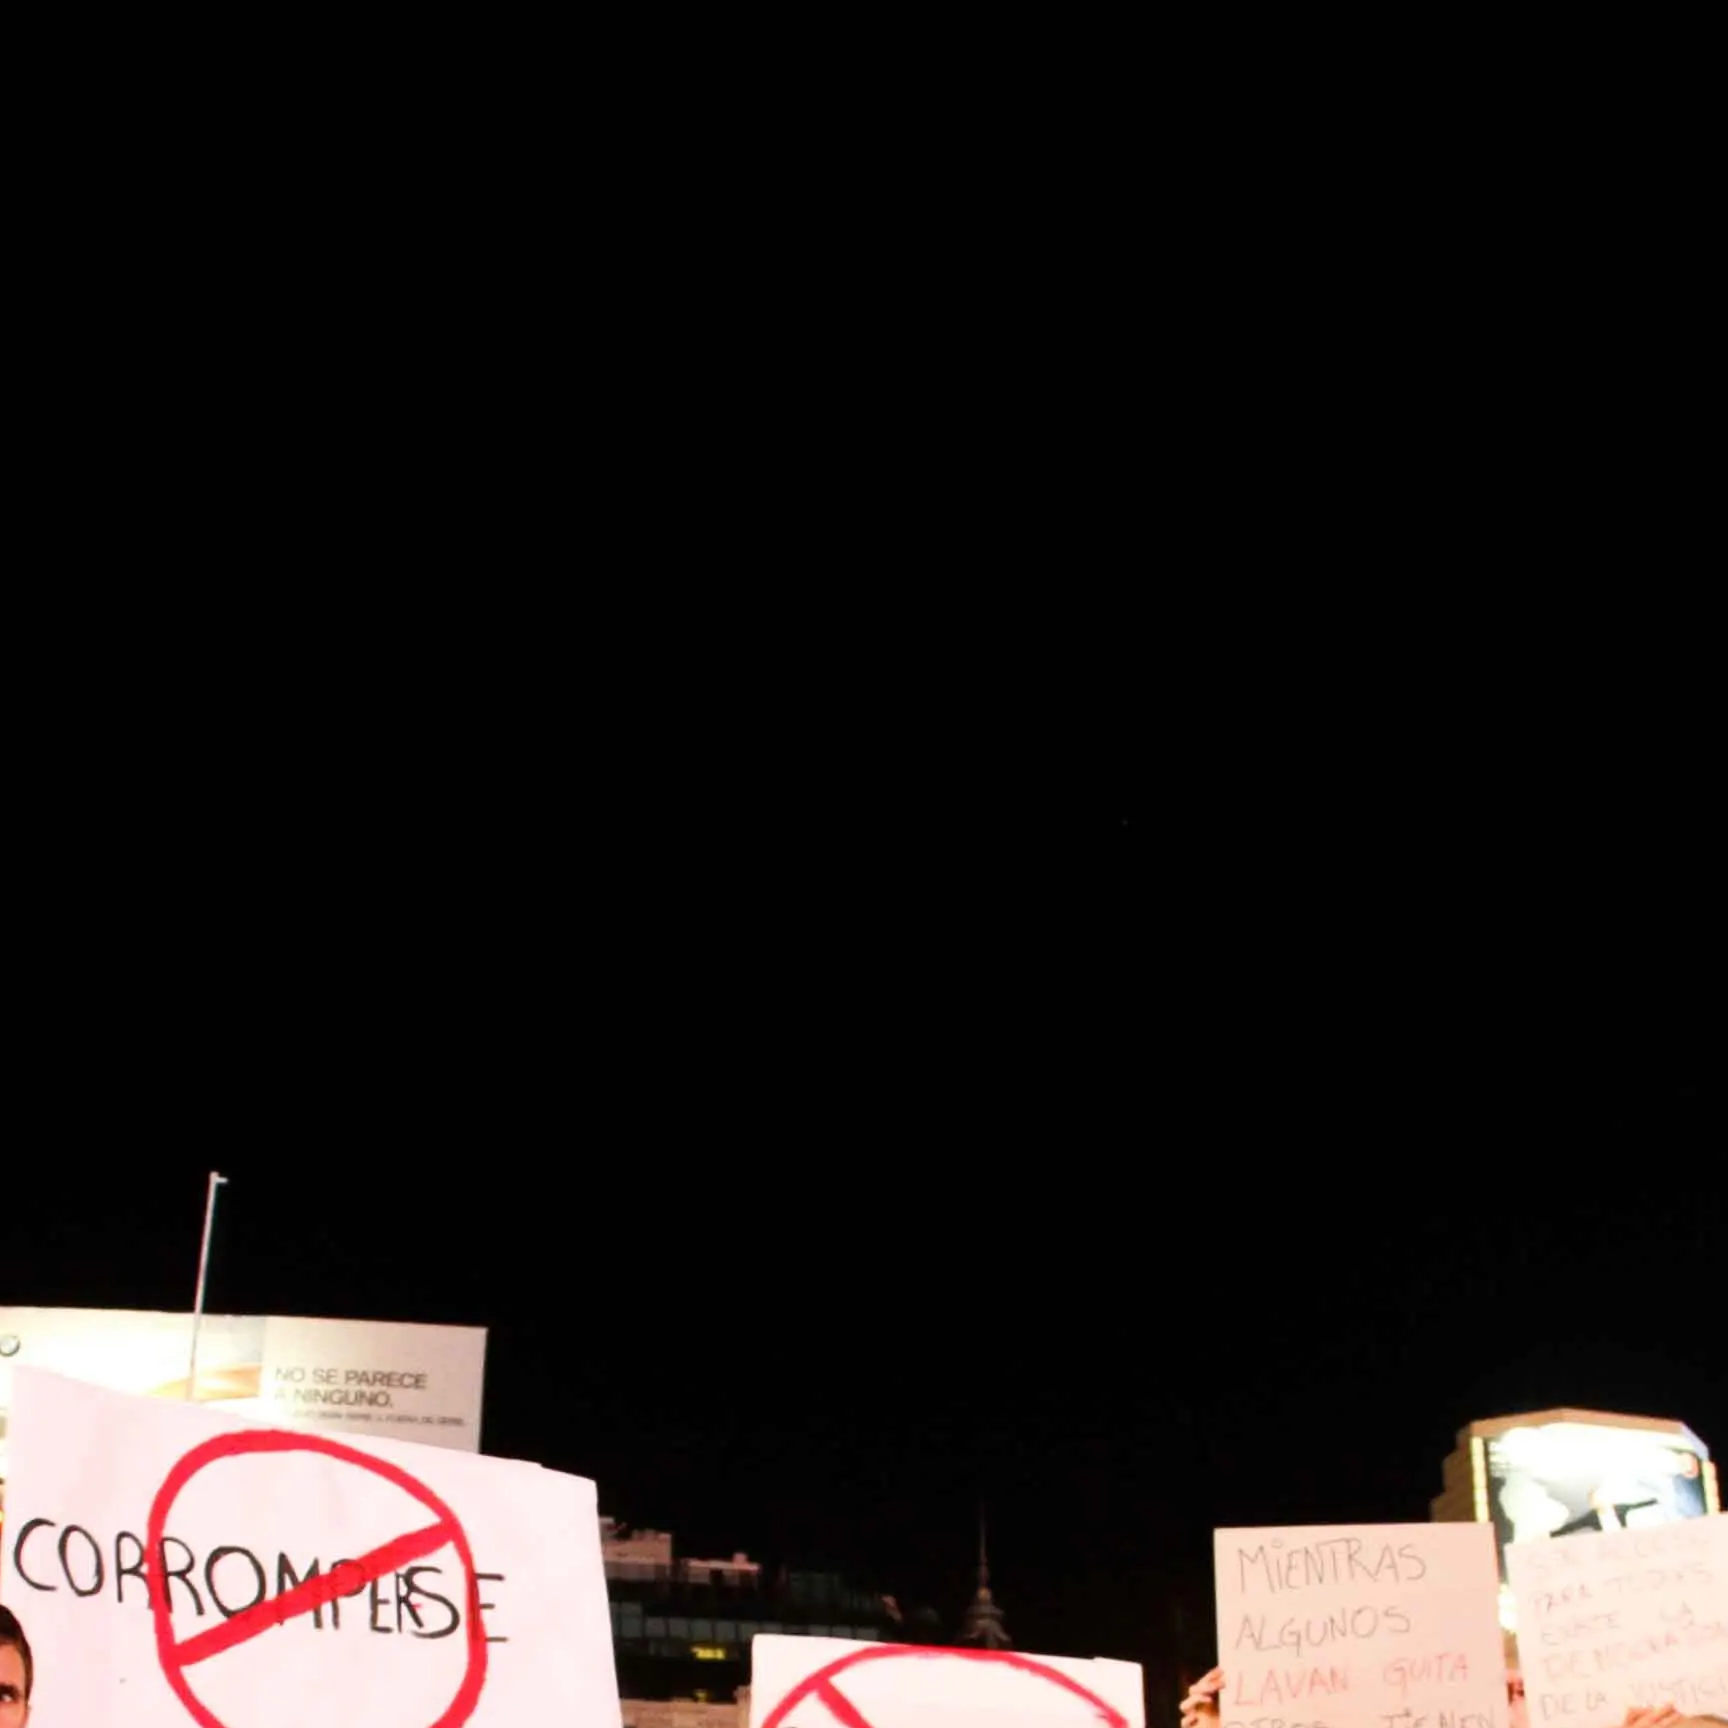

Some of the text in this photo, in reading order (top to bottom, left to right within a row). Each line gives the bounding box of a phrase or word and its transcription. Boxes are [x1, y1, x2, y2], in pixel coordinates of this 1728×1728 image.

[275, 1366, 429, 1390] NO SE PARECE
[12, 1517, 511, 1647] CORROMPERSE
[1238, 1536, 1428, 1595] MIENTRAS
[1234, 1604, 1412, 1659] ALGUNOS
[1233, 1650, 1470, 1709] LAVAN GUITA
